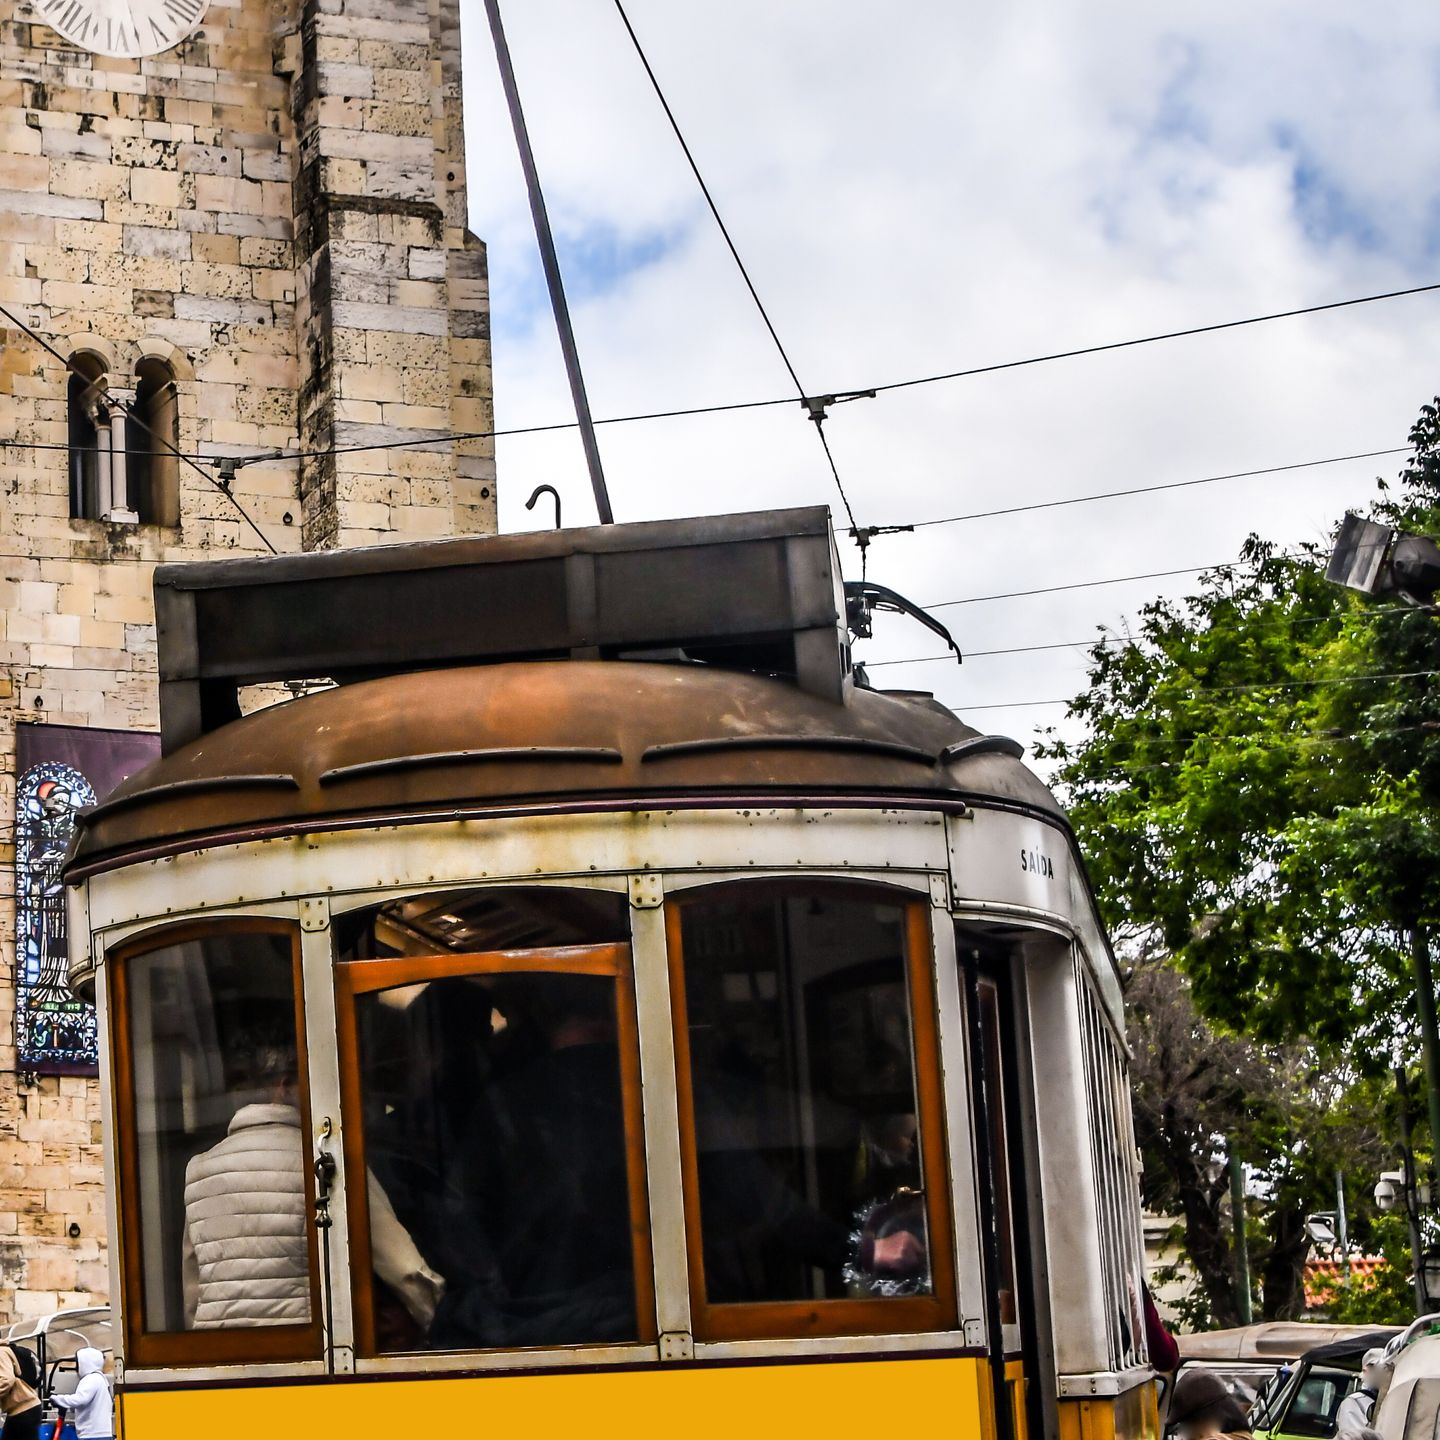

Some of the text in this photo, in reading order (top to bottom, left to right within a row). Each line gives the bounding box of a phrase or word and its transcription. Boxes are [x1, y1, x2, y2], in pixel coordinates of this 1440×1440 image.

[106, 18, 130, 53] VI
[148, 15, 170, 48] V
[1021, 845, 1054, 880] SAÍDA
